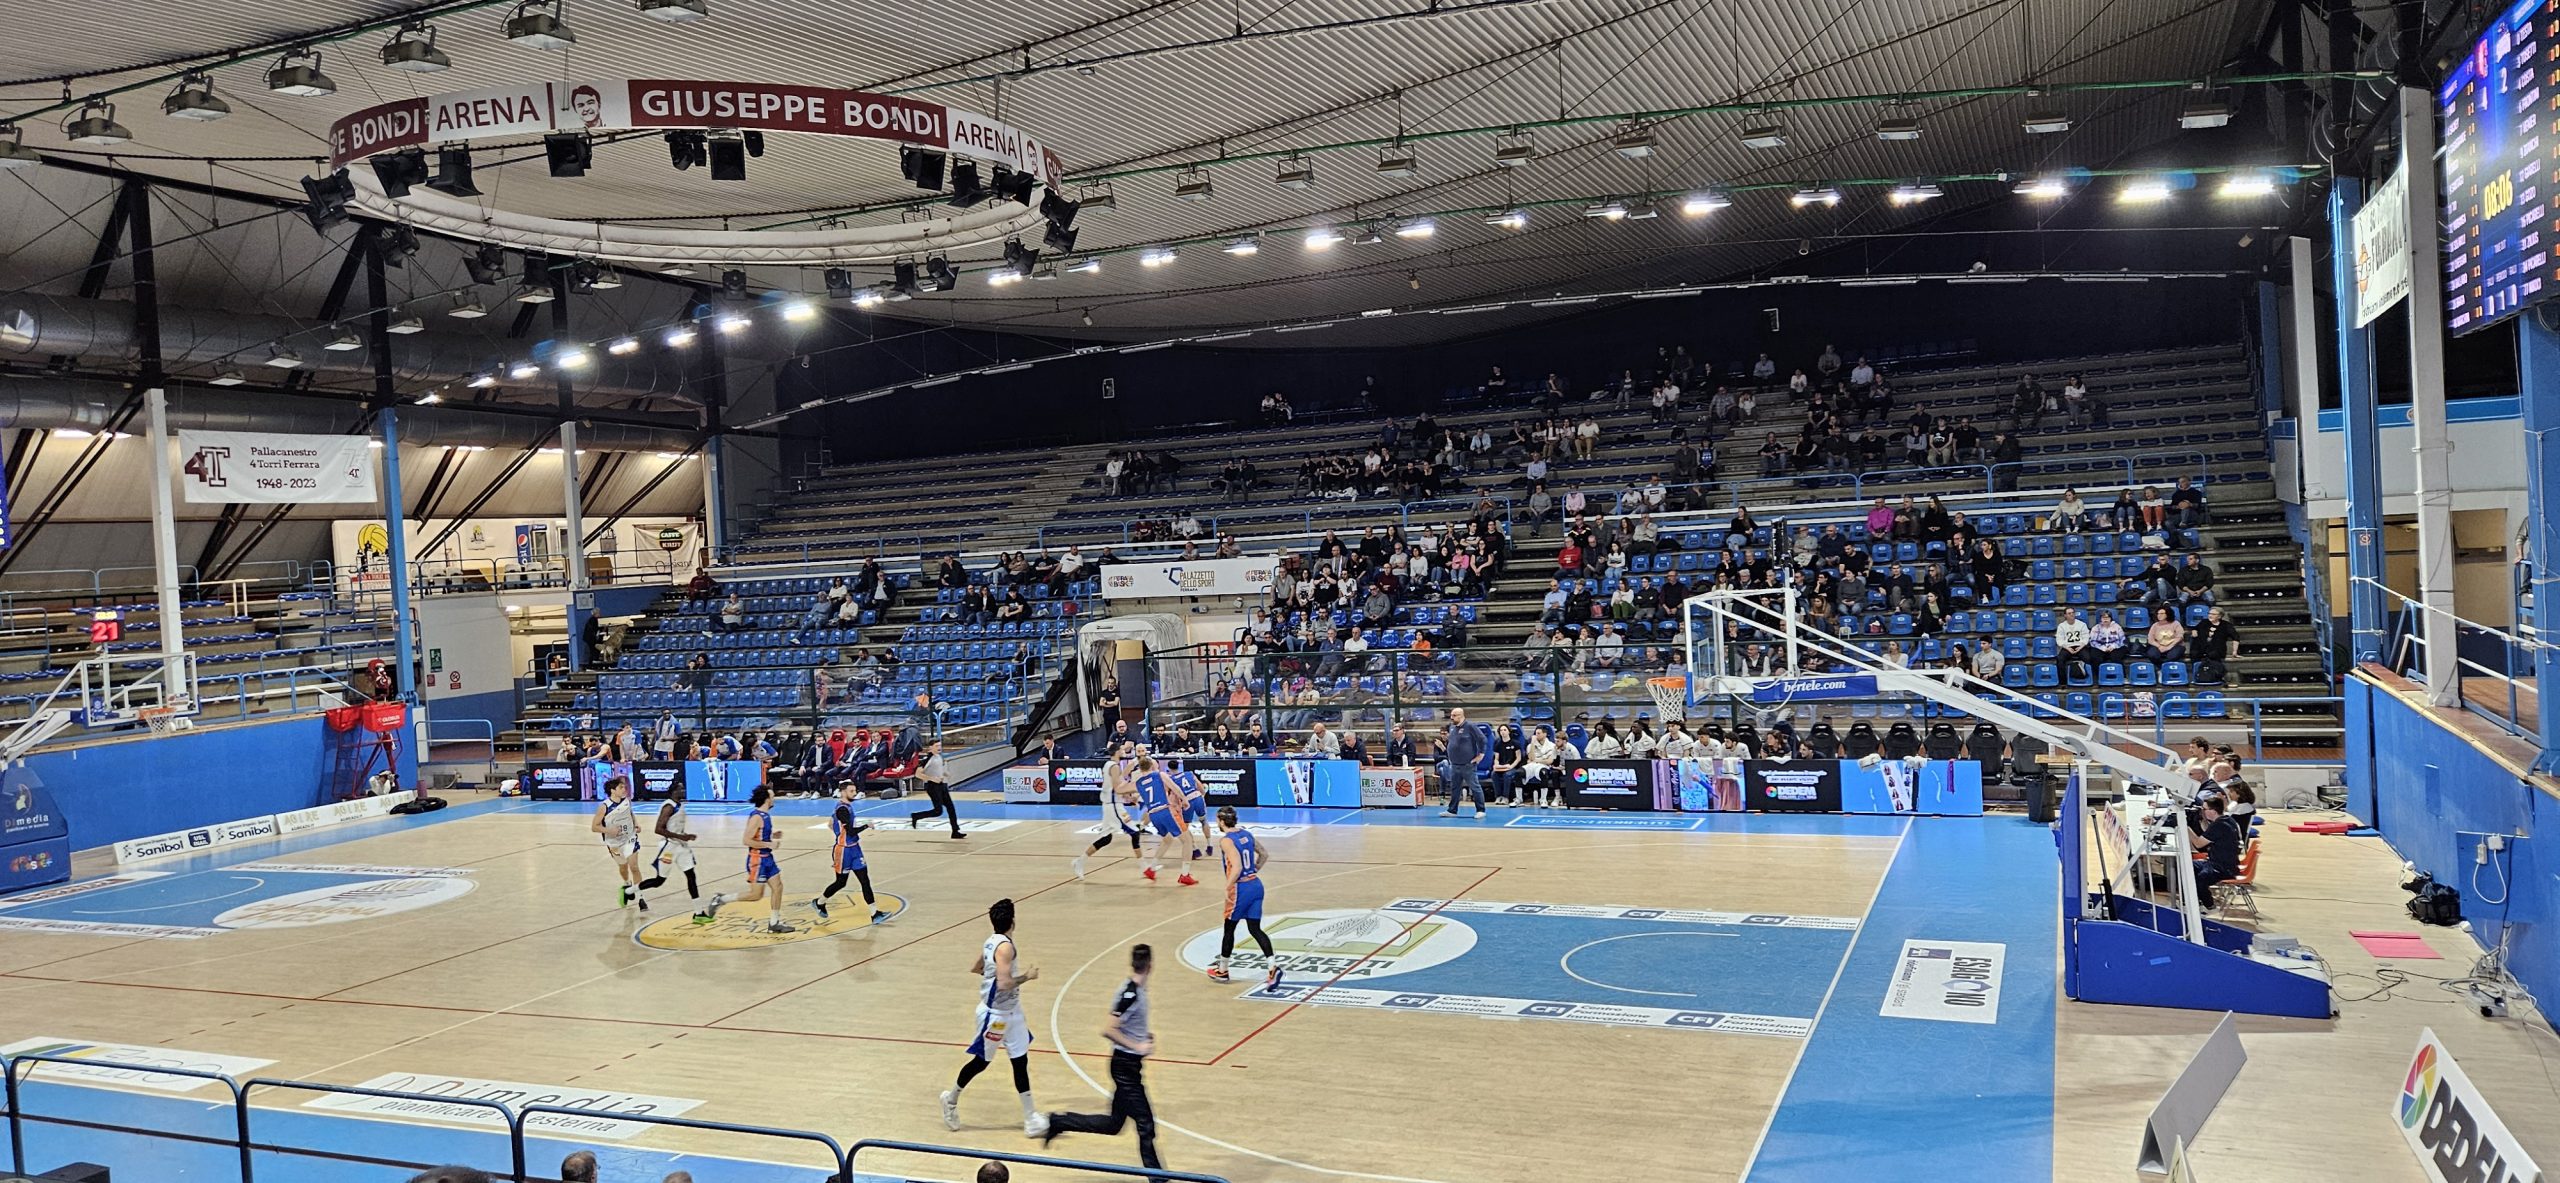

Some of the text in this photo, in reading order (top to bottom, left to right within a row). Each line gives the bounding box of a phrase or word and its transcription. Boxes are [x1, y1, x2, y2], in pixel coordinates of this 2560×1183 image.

[351, 109, 420, 150] BONDI
[437, 95, 540, 132] ARENA
[641, 89, 1018, 160] GIUSEPPE BONDI ARENA
[2484, 169, 2513, 220] 08:06
[250, 446, 318, 458] Pallacanestro
[250, 460, 320, 469] 4 Torri Ferrara
[1180, 570, 1215, 579] PALAZZETTO
[1198, 579, 1215, 587] SPORT
[92, 621, 119, 642] 21
[2066, 630, 2081, 643] 23
[1783, 680, 1846, 692] bertele.com
[542, 768, 572, 778] DEDEM
[1066, 767, 1103, 779] DEDEM
[1588, 768, 1637, 780] DEDEM
[1005, 777, 1031, 785] LEGA
[1182, 778, 1191, 789] 4
[1362, 779, 1394, 787] LEGA
[1145, 786, 1154, 802] 7
[1777, 786, 1817, 795] DEDEM
[228, 824, 273, 840] Sanibol
[136, 840, 184, 858] Sanibol
[1243, 849, 1250, 869] 0
[1750, 916, 1780, 924] CFI
[1394, 996, 1428, 1006] CFI
[1433, 1000, 1506, 1008] Formazione
[1426, 1004, 1503, 1013] Innovazione
[1530, 1005, 1563, 1014] CFI
[1572, 1009, 1651, 1018] Formazione
[1565, 1013, 1648, 1023] Innovazione
[1676, 1014, 1713, 1025] CFI
[1728, 1014, 1775, 1022] Centro
[1716, 1024, 1806, 1035] Innovazione
[1722, 1019, 1807, 1029] Formazione
[415, 1080, 658, 1117] Dimedia
[372, 1100, 497, 1120] pianificare
[526, 1110, 619, 1132] esterna
